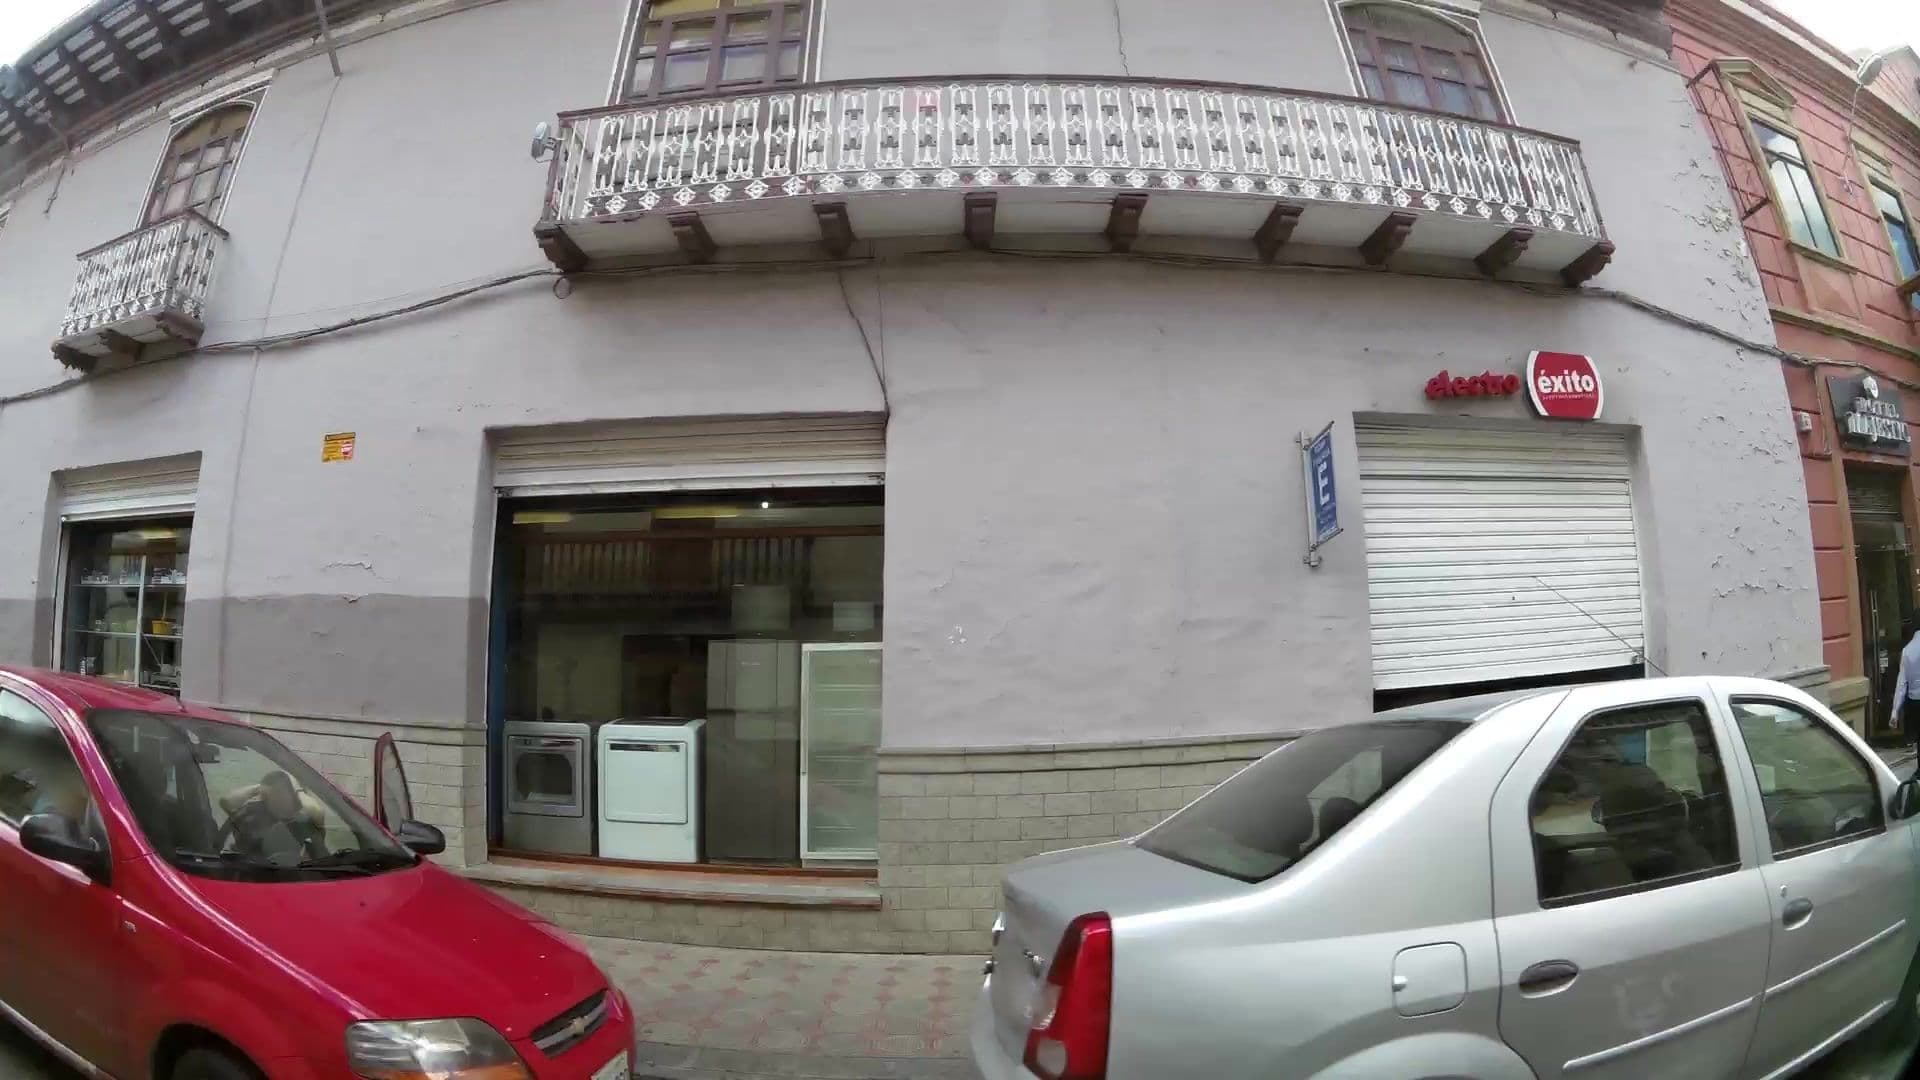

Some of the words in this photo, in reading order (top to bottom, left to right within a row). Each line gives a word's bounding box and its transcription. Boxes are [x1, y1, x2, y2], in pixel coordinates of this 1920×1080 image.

[1426, 371, 1520, 399] electro
[1538, 369, 1595, 393] éxito
[1318, 461, 1330, 506] E
